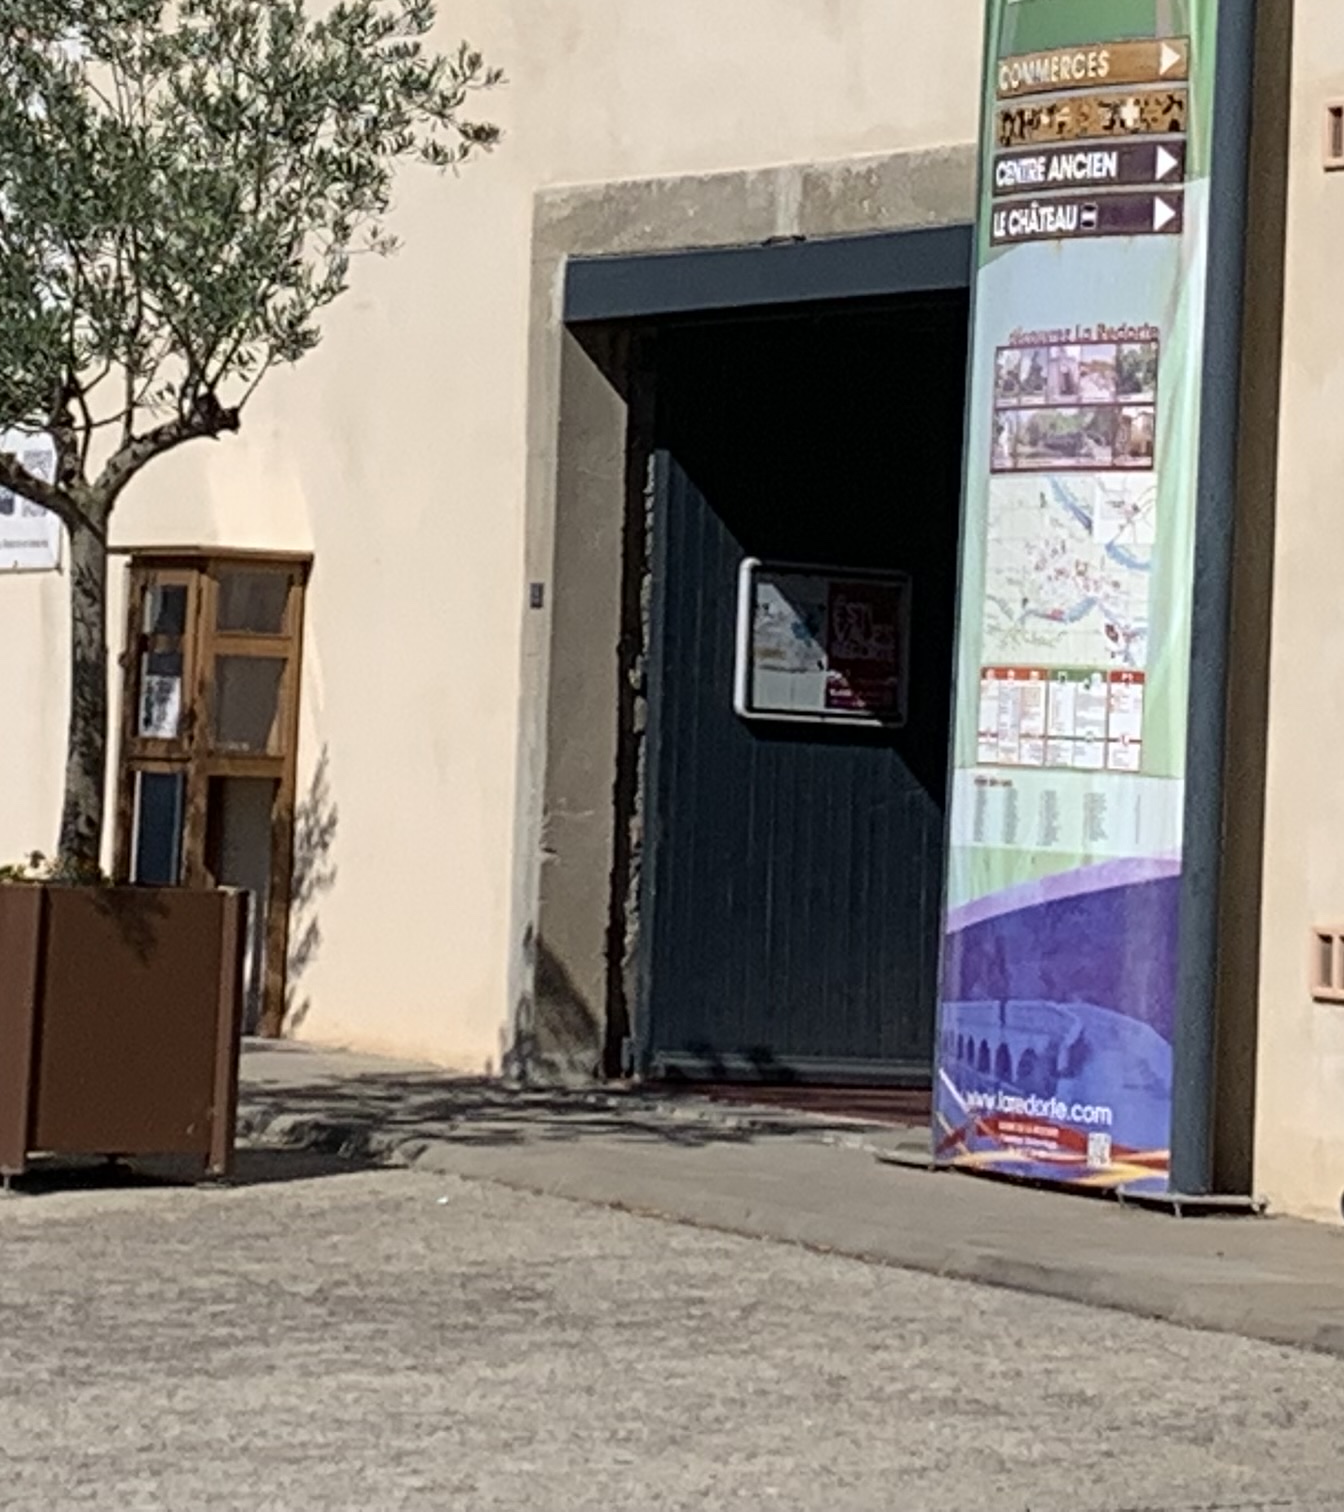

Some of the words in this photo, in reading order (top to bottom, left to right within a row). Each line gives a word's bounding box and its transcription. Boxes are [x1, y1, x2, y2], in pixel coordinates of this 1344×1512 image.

[998, 50, 1110, 90] COMMERCES
[996, 156, 1046, 187] CENTRE
[1047, 151, 1119, 181] ANCIEN
[993, 210, 1007, 237] LE
[1008, 200, 1078, 236] CHÂTEAU
